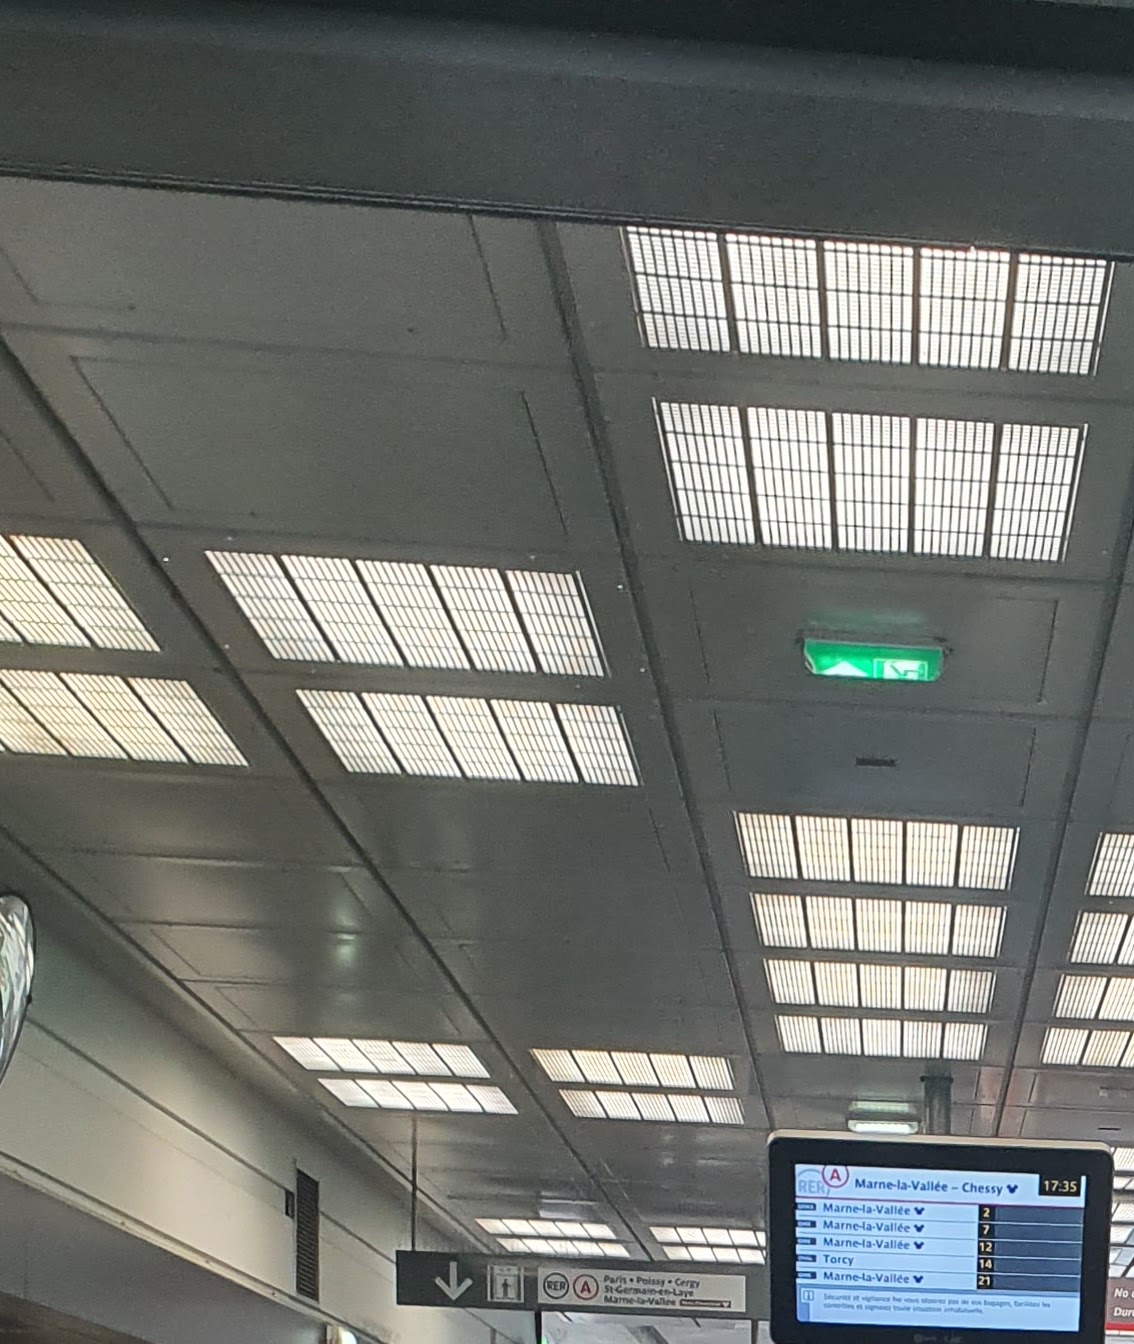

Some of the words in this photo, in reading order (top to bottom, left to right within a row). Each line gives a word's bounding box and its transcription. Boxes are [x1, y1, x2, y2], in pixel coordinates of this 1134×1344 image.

[798, 1179, 825, 1194] RER
[829, 1168, 842, 1182] A
[854, 1178, 948, 1192] Marne-la-Vallée
[962, 1182, 1003, 1196] Chessy
[823, 1202, 911, 1216] Marne-la-Vallée
[983, 1208, 990, 1218] 2
[823, 1220, 911, 1233] Marne-la-Vallée
[983, 1225, 990, 1235] 7
[823, 1237, 911, 1250] Marne-la-Vallée
[979, 1242, 993, 1252] 12
[823, 1254, 855, 1267] Torcy
[979, 1259, 993, 1269] 14
[604, 1274, 627, 1285] Paris
[636, 1276, 665, 1288] Poissy
[674, 1278, 700, 1289] Cergy
[823, 1271, 910, 1284] Marne-la-Vallée
[978, 1276, 991, 1286] 21
[546, 1280, 566, 1291] RER
[580, 1281, 592, 1294] A
[604, 1285, 694, 1298] St-Germain-en-Laye
[1113, 1288, 1128, 1298] No
